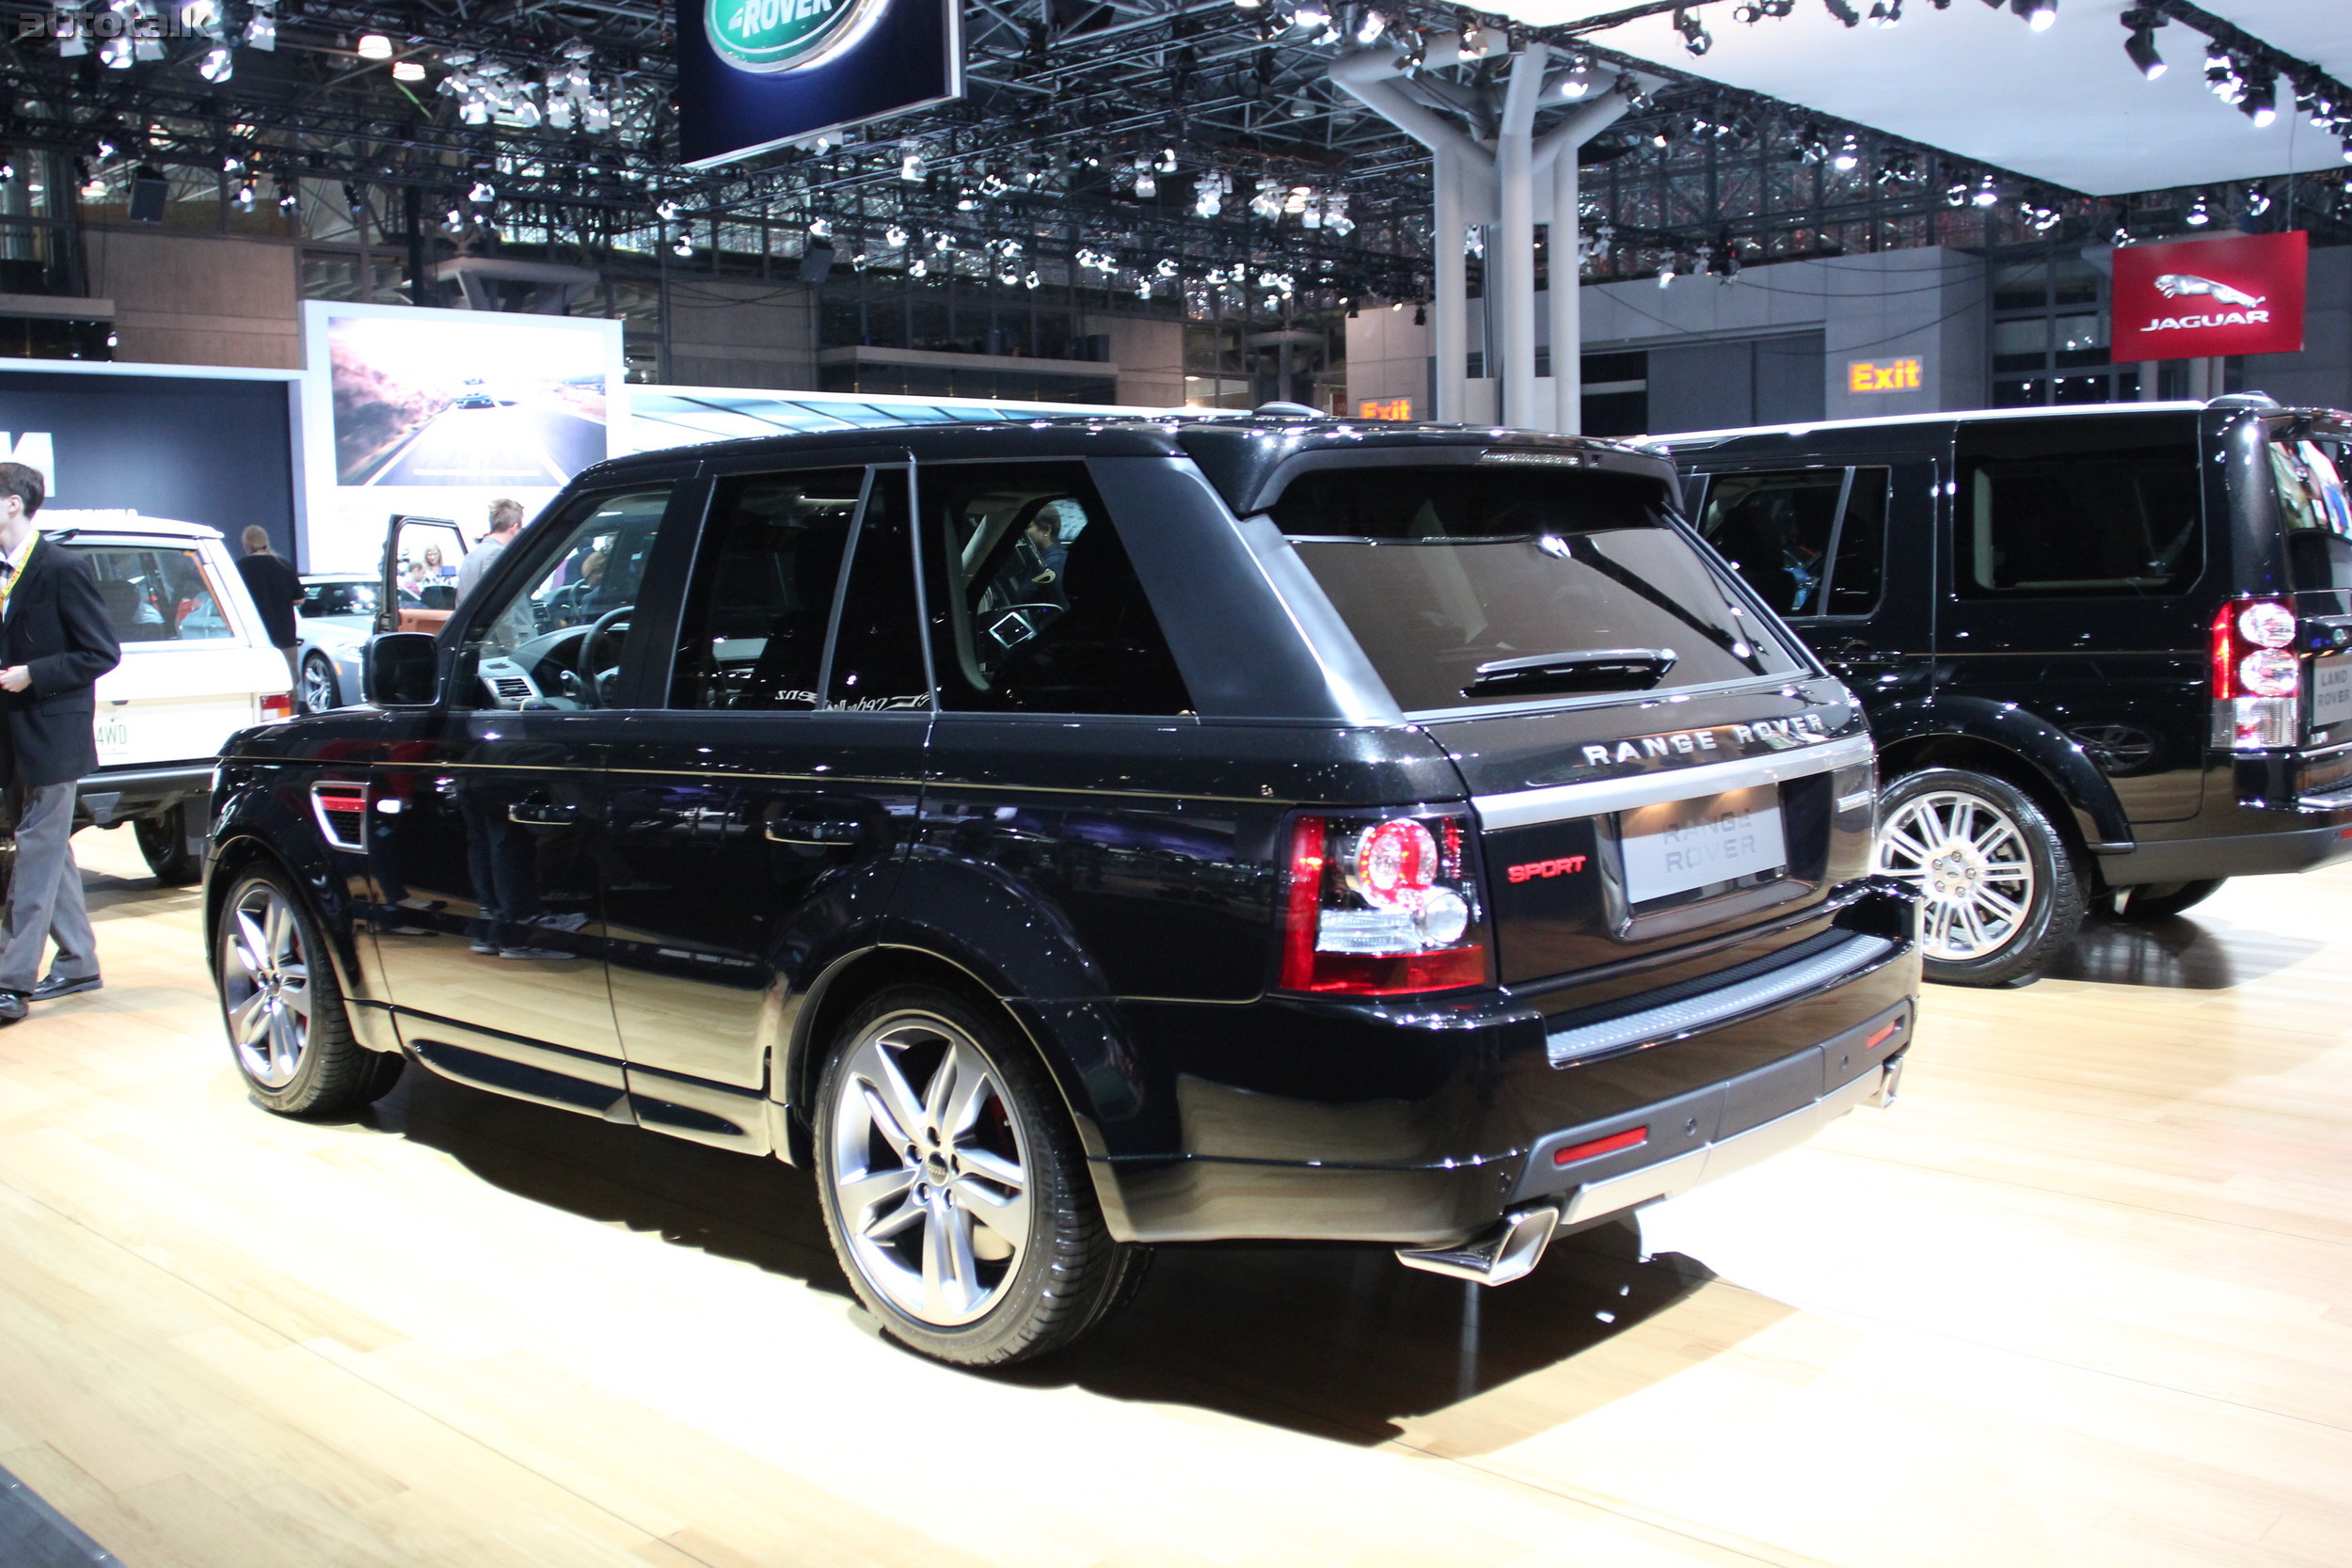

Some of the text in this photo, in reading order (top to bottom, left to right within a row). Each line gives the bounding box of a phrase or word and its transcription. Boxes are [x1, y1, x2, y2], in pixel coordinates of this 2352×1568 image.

[2138, 310, 2269, 332] JAGUAR
[1850, 358, 1920, 392] Exit
[1360, 399, 1410, 420] Exit
[2320, 669, 2348, 687] LAND
[2317, 689, 2351, 707] ROVER
[1582, 713, 1825, 767] RANGE ROVER
[1665, 834, 1756, 874] ROVER
[1507, 855, 1587, 883] SPORT
